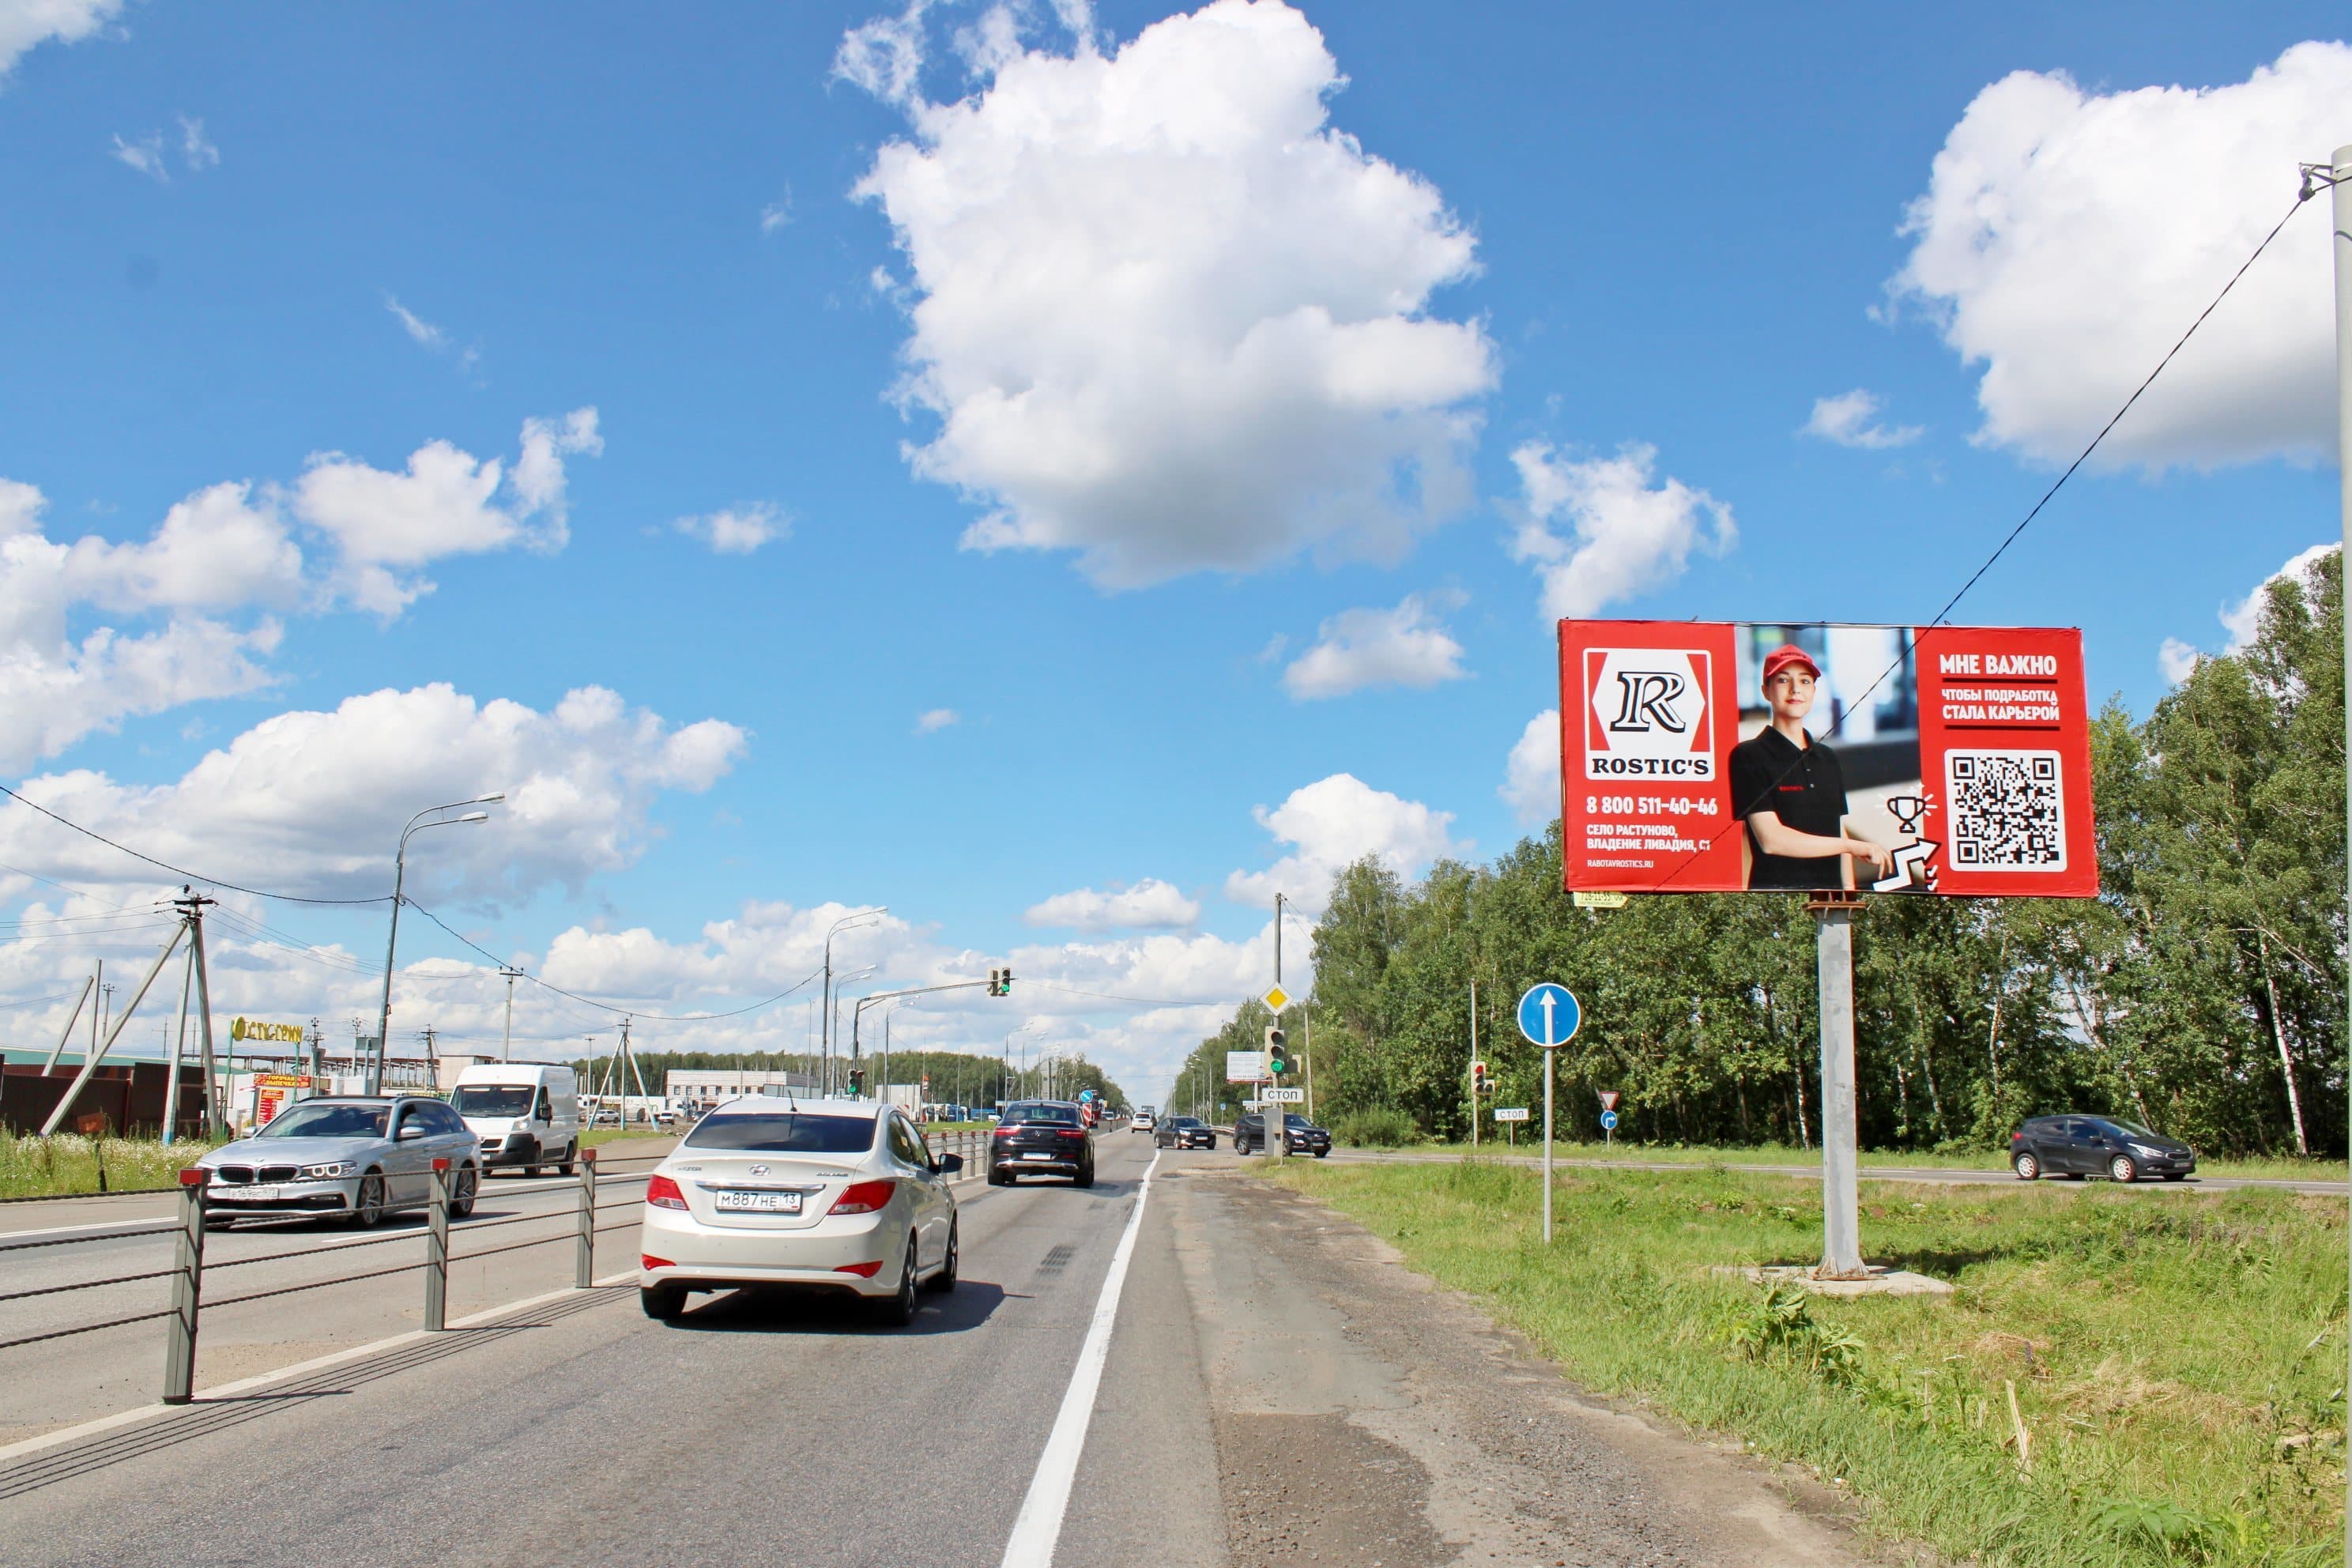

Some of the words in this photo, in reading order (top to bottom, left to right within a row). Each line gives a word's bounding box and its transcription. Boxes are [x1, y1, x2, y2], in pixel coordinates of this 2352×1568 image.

[1939, 654, 1981, 674] МНЕ
[1985, 654, 2057, 676] ВАЖНО
[1941, 689, 1982, 701] ЧТОБЫ
[1984, 689, 2059, 703] ПОДРАБОТКА
[1943, 705, 1987, 720] СТАЛА
[1988, 700, 2060, 721] КАРЬЕРОЙ
[1592, 758, 1709, 775] ROSTIC'S
[1586, 796, 1597, 814] 8
[1601, 796, 1634, 814] 800
[1638, 797, 1718, 816] 511-40-46
[1586, 824, 1615, 835] СЕЛО
[1616, 825, 1679, 838] РАСТУНОВО,
[1586, 838, 1643, 851] ВЛАДЕНИЕ
[1644, 839, 1698, 853] ЛИВАДИЯ,
[1587, 859, 1654, 869] RABOTAVROSTICS.RU
[1268, 1090, 1298, 1100] СТОП
[1499, 1110, 1525, 1119] СТОП
